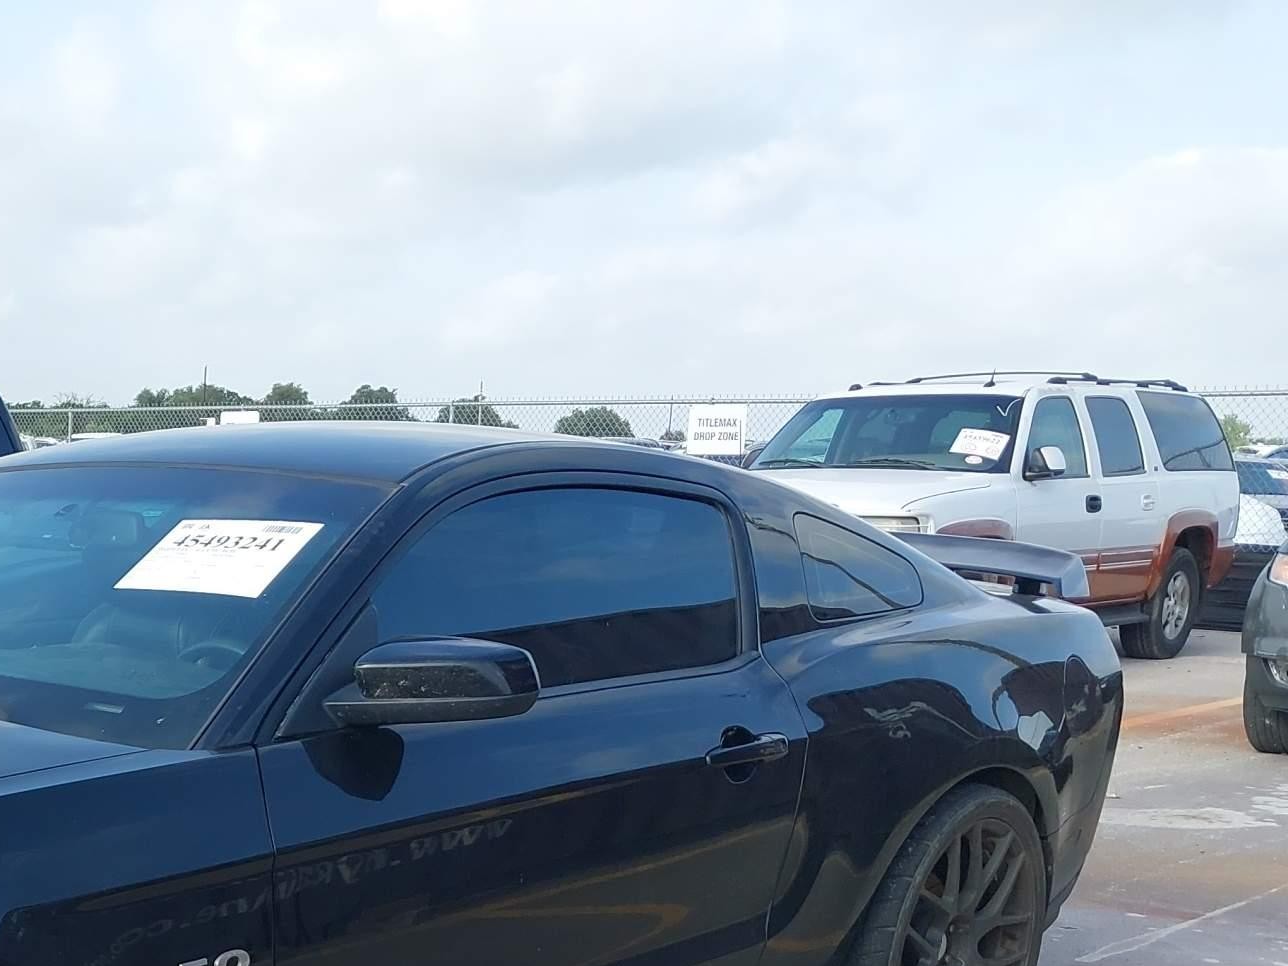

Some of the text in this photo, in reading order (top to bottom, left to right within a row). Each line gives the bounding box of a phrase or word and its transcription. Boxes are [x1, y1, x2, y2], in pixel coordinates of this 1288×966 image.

[698, 418, 738, 428] TITLEMAX
[693, 431, 739, 441] DROP ZONE
[172, 534, 285, 551] 45493241
